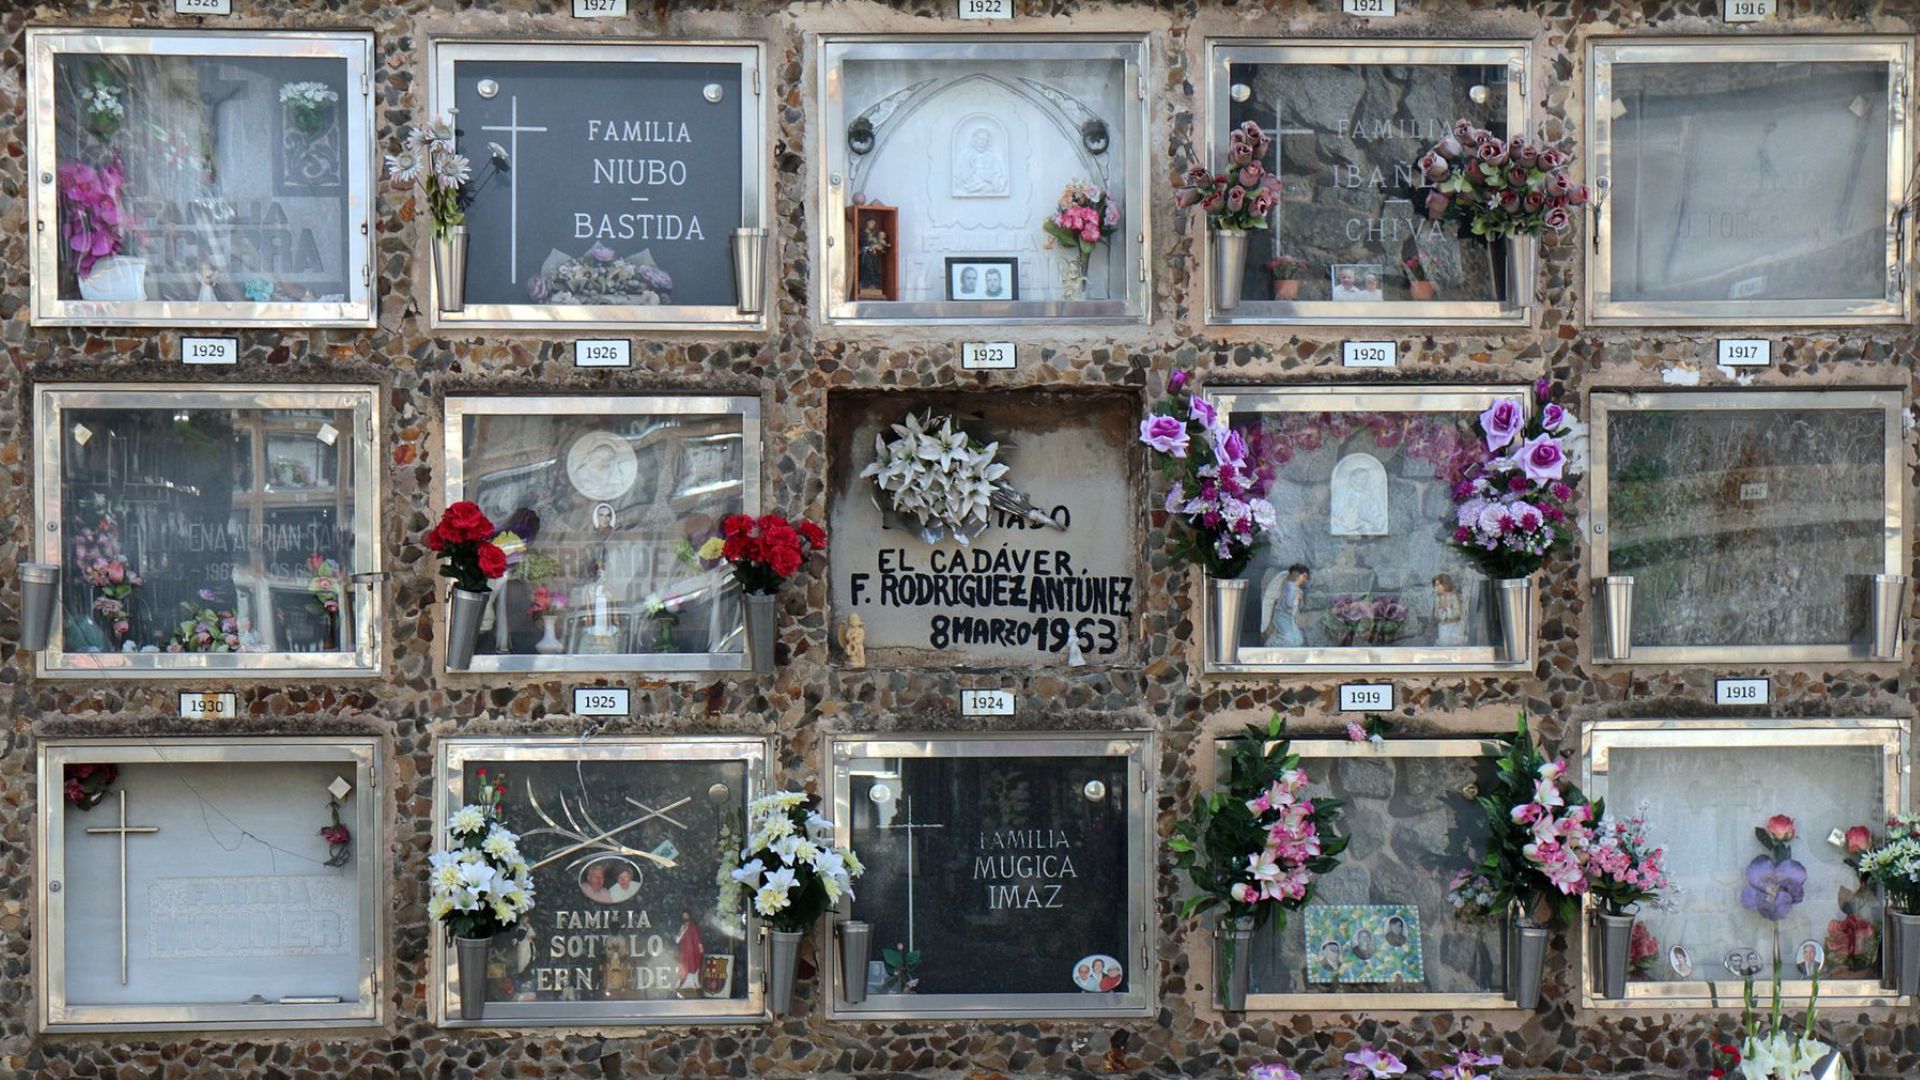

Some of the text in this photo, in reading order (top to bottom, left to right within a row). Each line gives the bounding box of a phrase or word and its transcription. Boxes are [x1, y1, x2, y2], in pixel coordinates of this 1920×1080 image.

[584, 0, 616, 11] 1927
[969, 0, 1002, 13] 1922
[1353, 0, 1384, 12] 1921
[1734, 2, 1766, 16] 1916
[587, 119, 692, 144] FAMILIA
[1338, 119, 1454, 140] FAMILIA
[592, 158, 687, 186] NIUBO
[1333, 160, 1448, 188] IBAÑE
[133, 201, 288, 226] FAMLIA
[573, 213, 705, 241] BASTIDA
[1345, 217, 1446, 242] CHIVA
[192, 344, 225, 357] 1929
[586, 346, 617, 359] 1926
[973, 349, 1003, 361] 1923
[1353, 348, 1385, 361] 1920
[1728, 346, 1758, 358] 1917
[878, 542, 1074, 575] EL CADÁVER
[851, 568, 1133, 619] F. RODRIGUEZ ANTÚNEZ
[930, 615, 1119, 654] 8 MARZO 1963
[1350, 691, 1380, 704] 1919
[1726, 686, 1757, 699] 1918
[190, 699, 224, 714] 1930
[584, 695, 616, 709] 1925
[971, 696, 1004, 710] 1924
[973, 855, 1078, 879] MUGICA
[989, 884, 1064, 909] IMAZ
[550, 934, 664, 959] SOTLO
[530, 967, 682, 991] ERNDE
